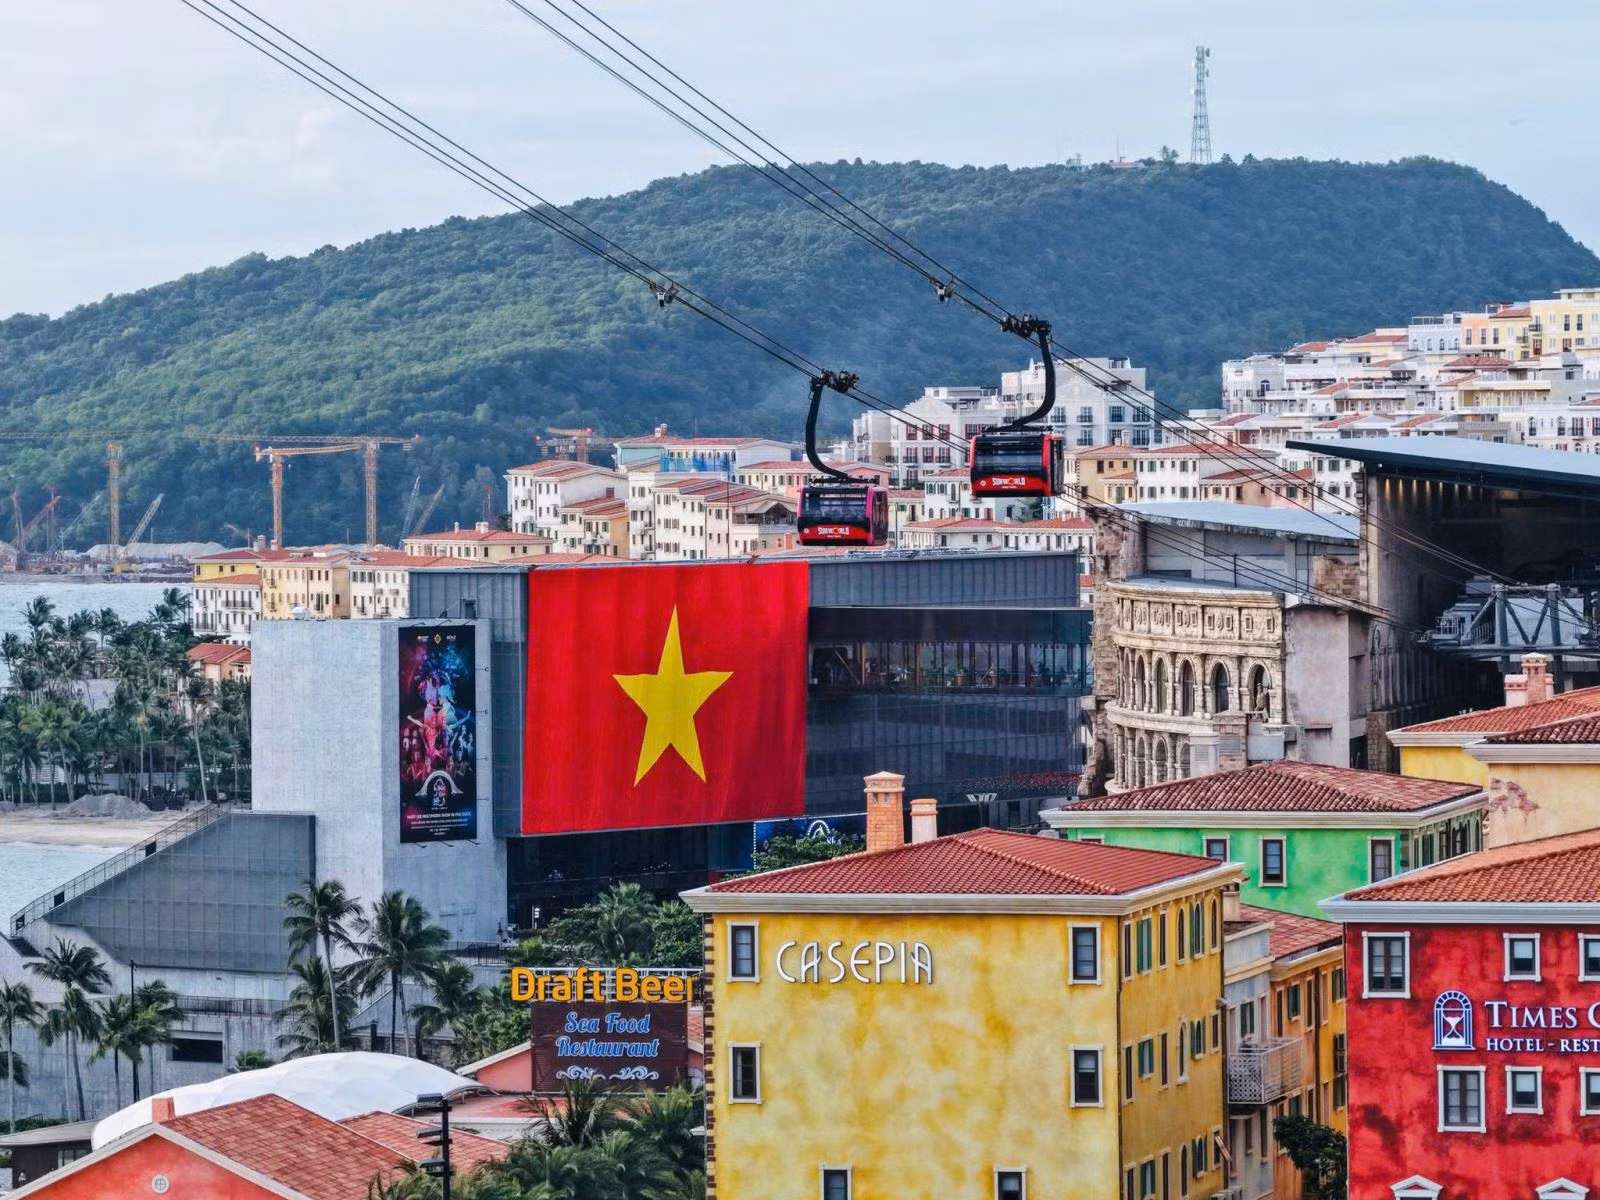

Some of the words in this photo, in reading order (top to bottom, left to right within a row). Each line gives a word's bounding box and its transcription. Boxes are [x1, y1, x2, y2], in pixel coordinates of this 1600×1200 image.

[776, 940, 933, 984] CASEPIA
[511, 966, 606, 1002] Draft
[564, 1011, 601, 1033] Sea
[604, 1012, 651, 1033] Food
[1484, 1000, 1577, 1029] TIMES
[555, 1035, 660, 1057] Restaurant
[1486, 1038, 1544, 1051] HOTEL
